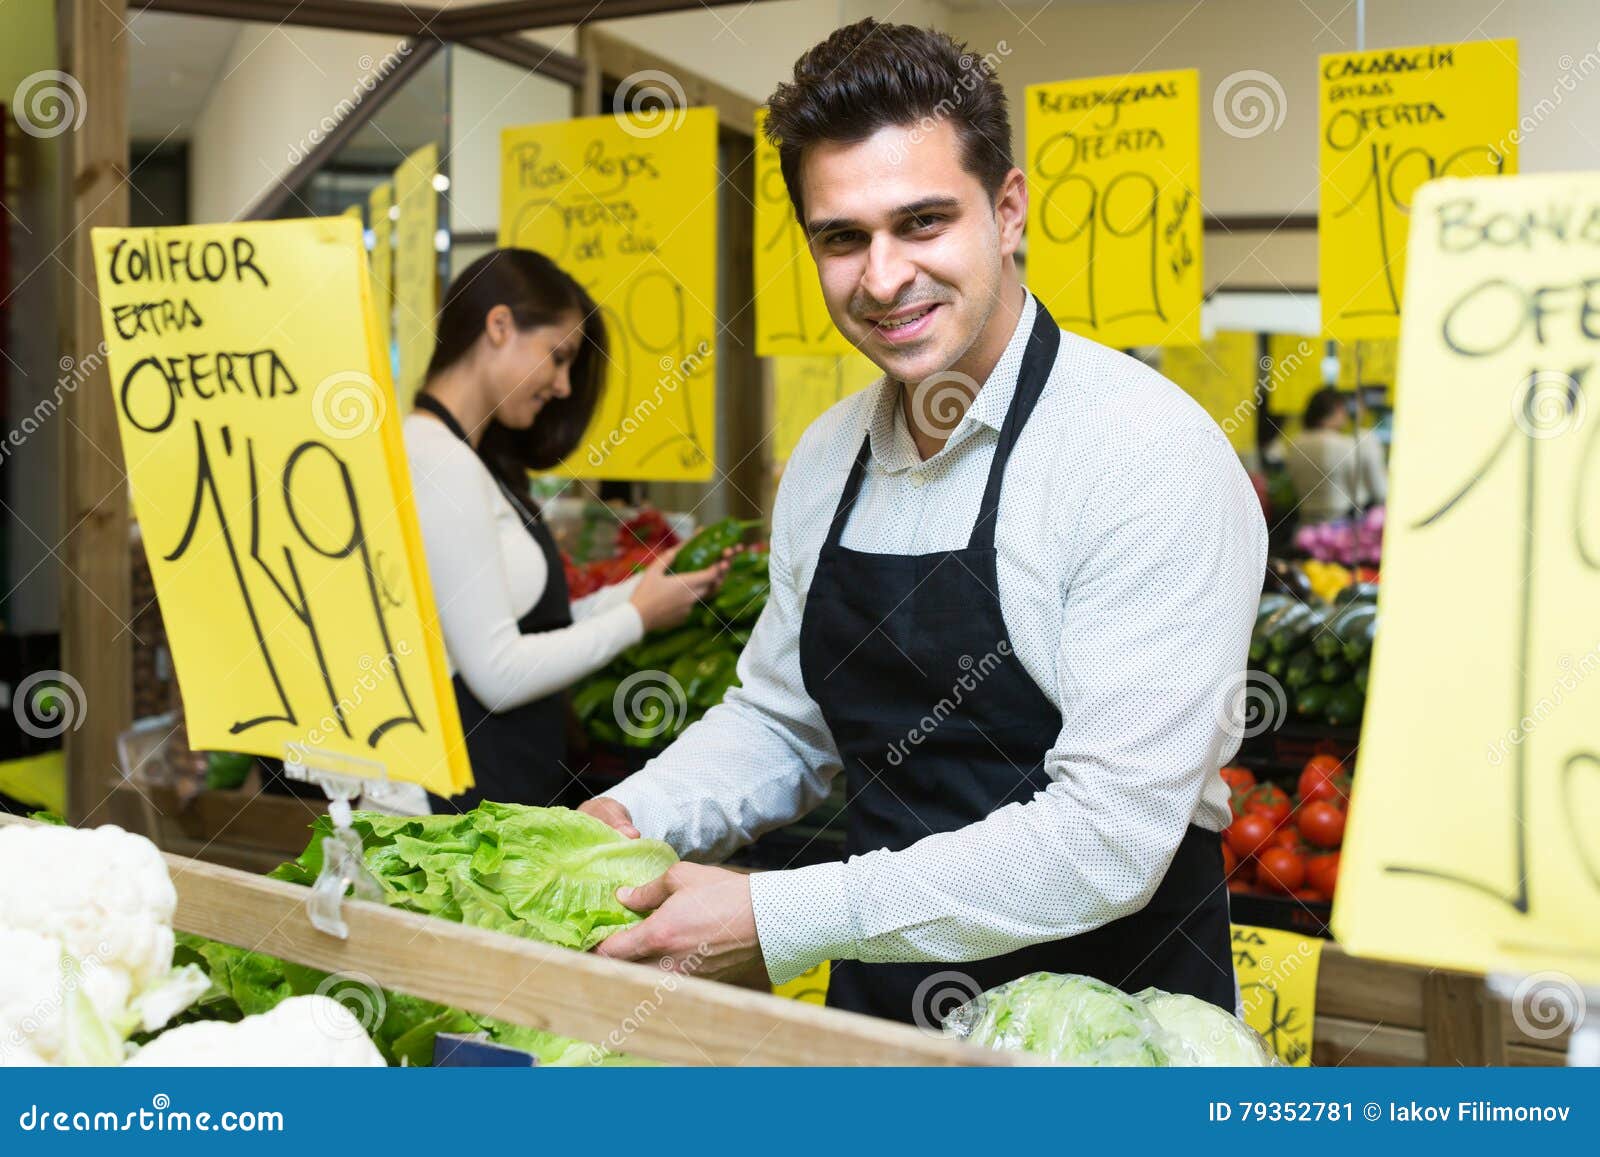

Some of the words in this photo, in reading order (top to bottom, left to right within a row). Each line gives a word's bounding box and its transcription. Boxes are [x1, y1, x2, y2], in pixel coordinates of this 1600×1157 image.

[1326, 102, 1446, 151] OFERTA
[1035, 130, 1165, 180] OFERTA
[121, 348, 298, 433] OFERTA
